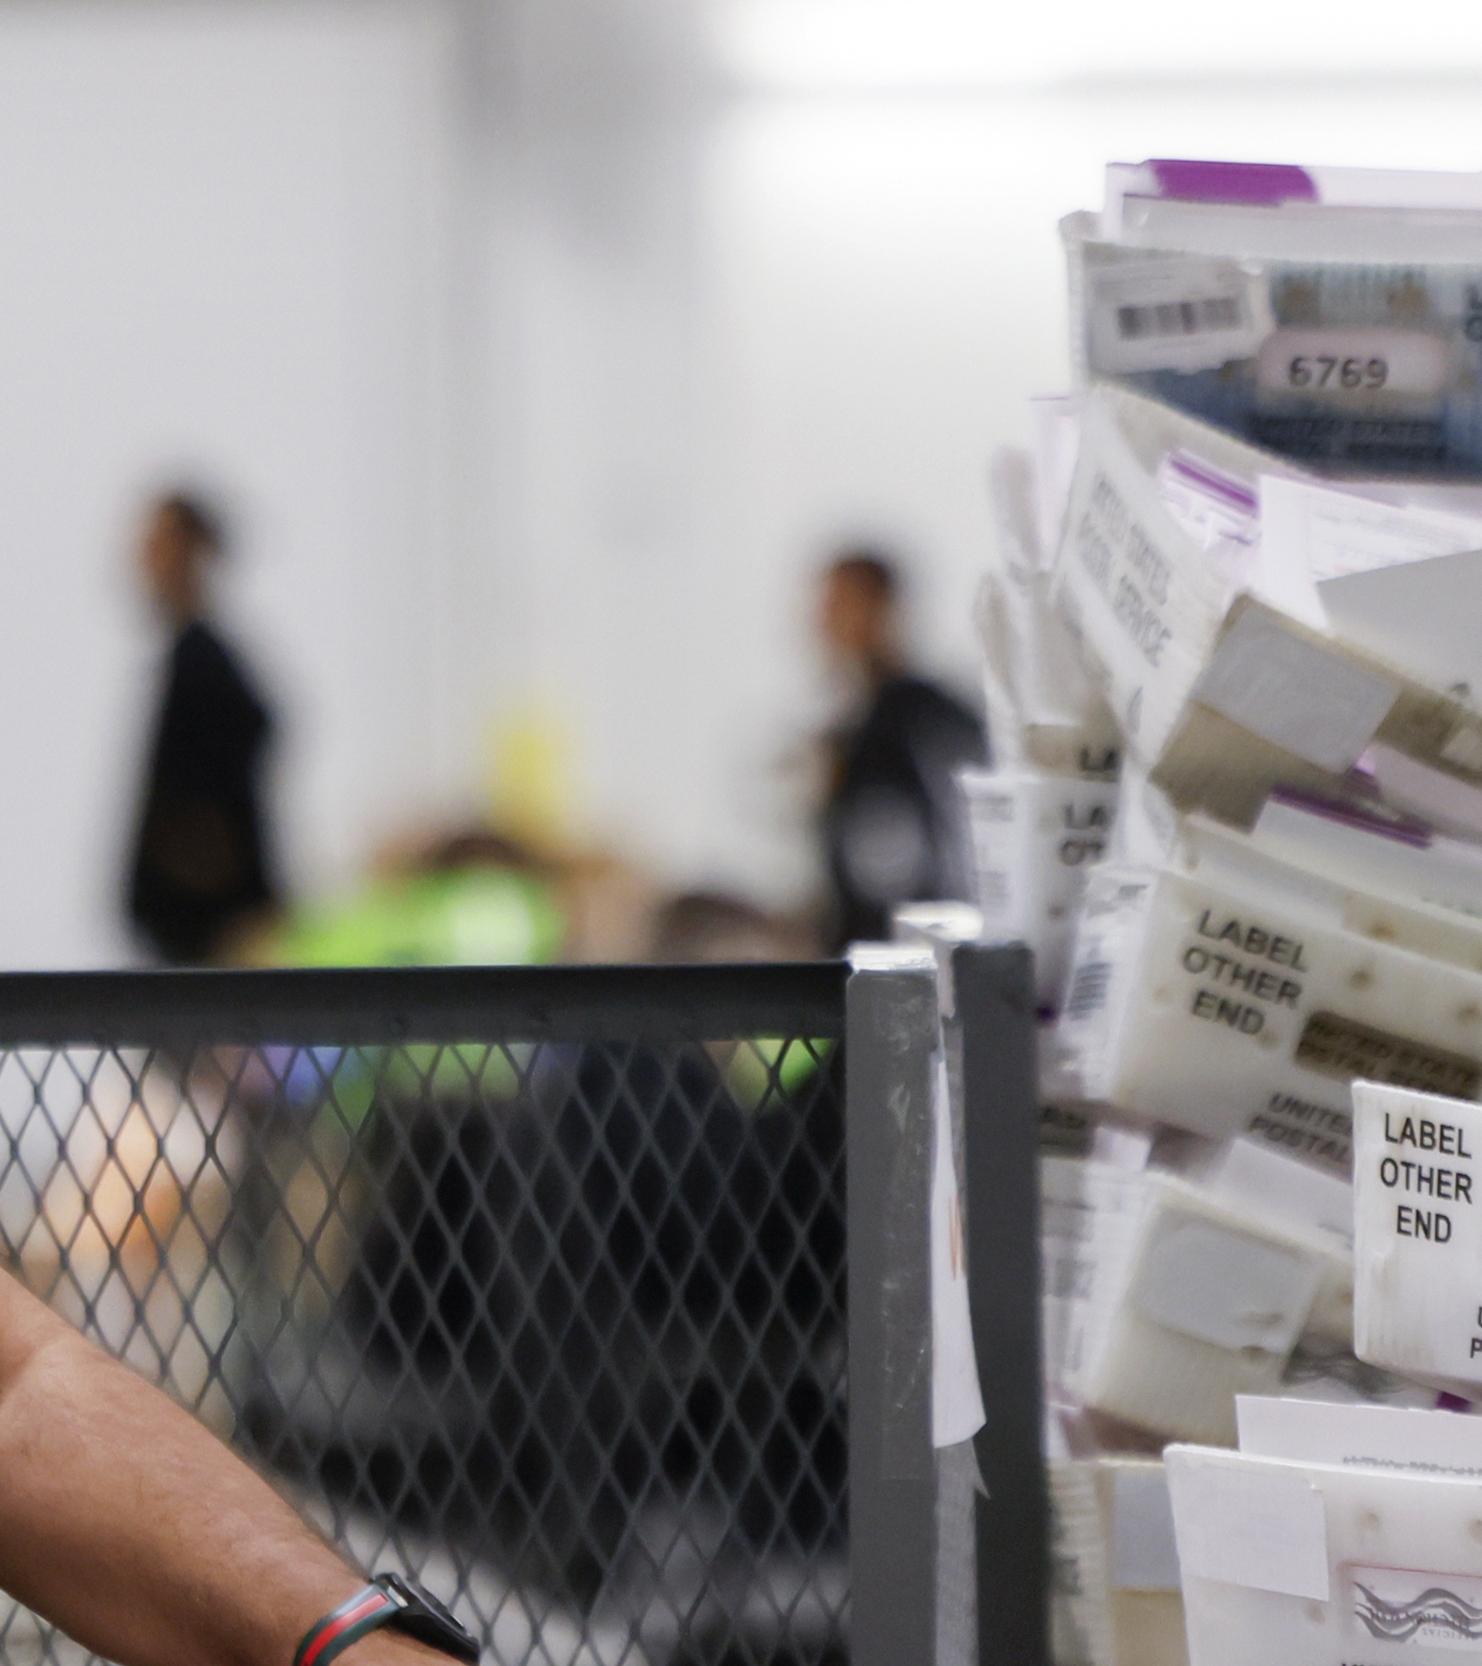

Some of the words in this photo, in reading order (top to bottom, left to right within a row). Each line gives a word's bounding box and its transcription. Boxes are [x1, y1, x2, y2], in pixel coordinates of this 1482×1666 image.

[1288, 357, 1388, 388] 6769
[1198, 909, 1309, 972] LABEL
[1182, 946, 1304, 1010] OTHER
[1189, 989, 1265, 1037] END
[1267, 1092, 1351, 1137] UNITE
[1383, 1112, 1472, 1160] LABEL
[1380, 1158, 1473, 1204] OTHER
[1396, 1205, 1452, 1244] END
